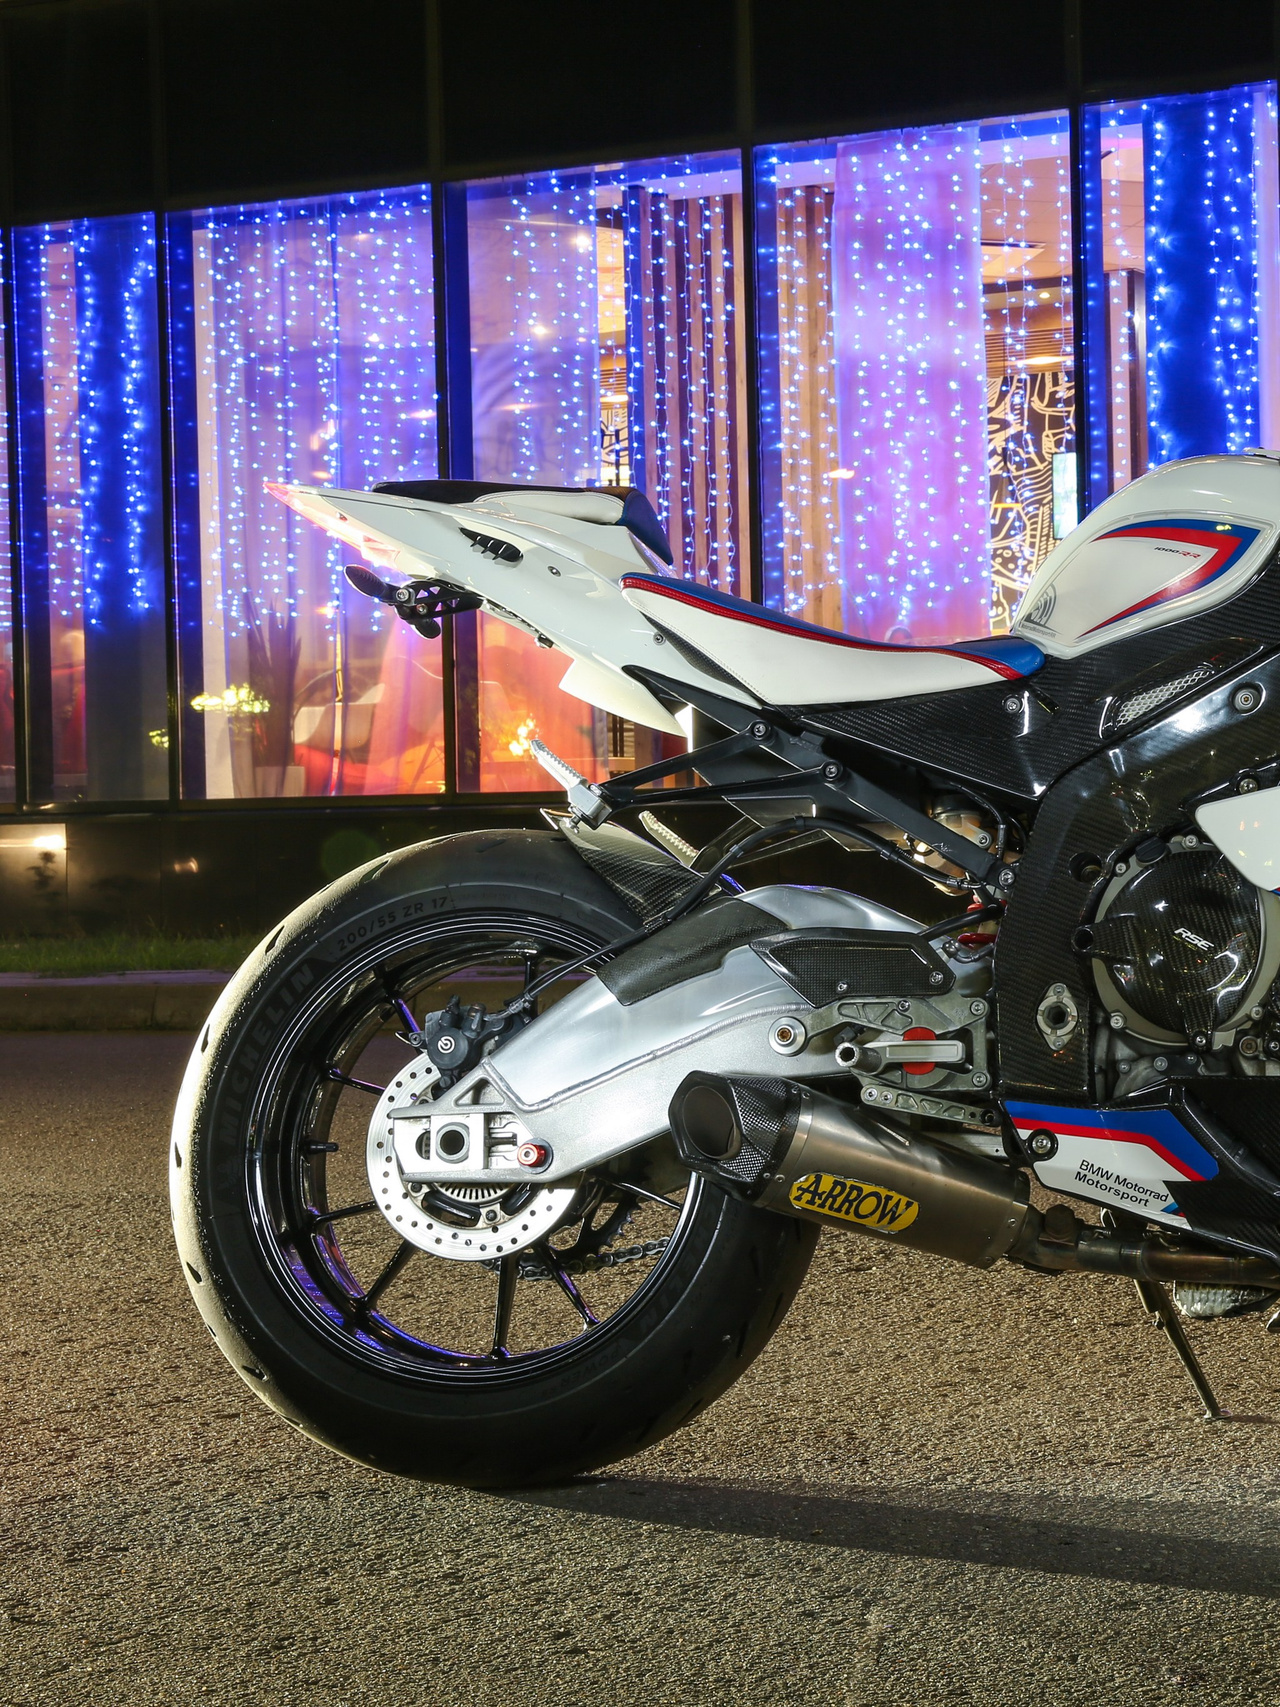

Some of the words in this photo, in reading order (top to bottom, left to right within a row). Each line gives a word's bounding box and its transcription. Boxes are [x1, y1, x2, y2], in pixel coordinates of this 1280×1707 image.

[337, 911, 397, 951] 200/55
[402, 902, 424, 918] ZR
[431, 896, 448, 909] 17
[1173, 927, 1214, 951] RSE
[218, 962, 316, 1148] MICHELIN
[793, 1174, 914, 1226] ARROW
[1074, 1171, 1149, 1207] Motorsport
[1079, 1159, 1114, 1181] BMW
[1113, 1174, 1170, 1203] Motorrad
